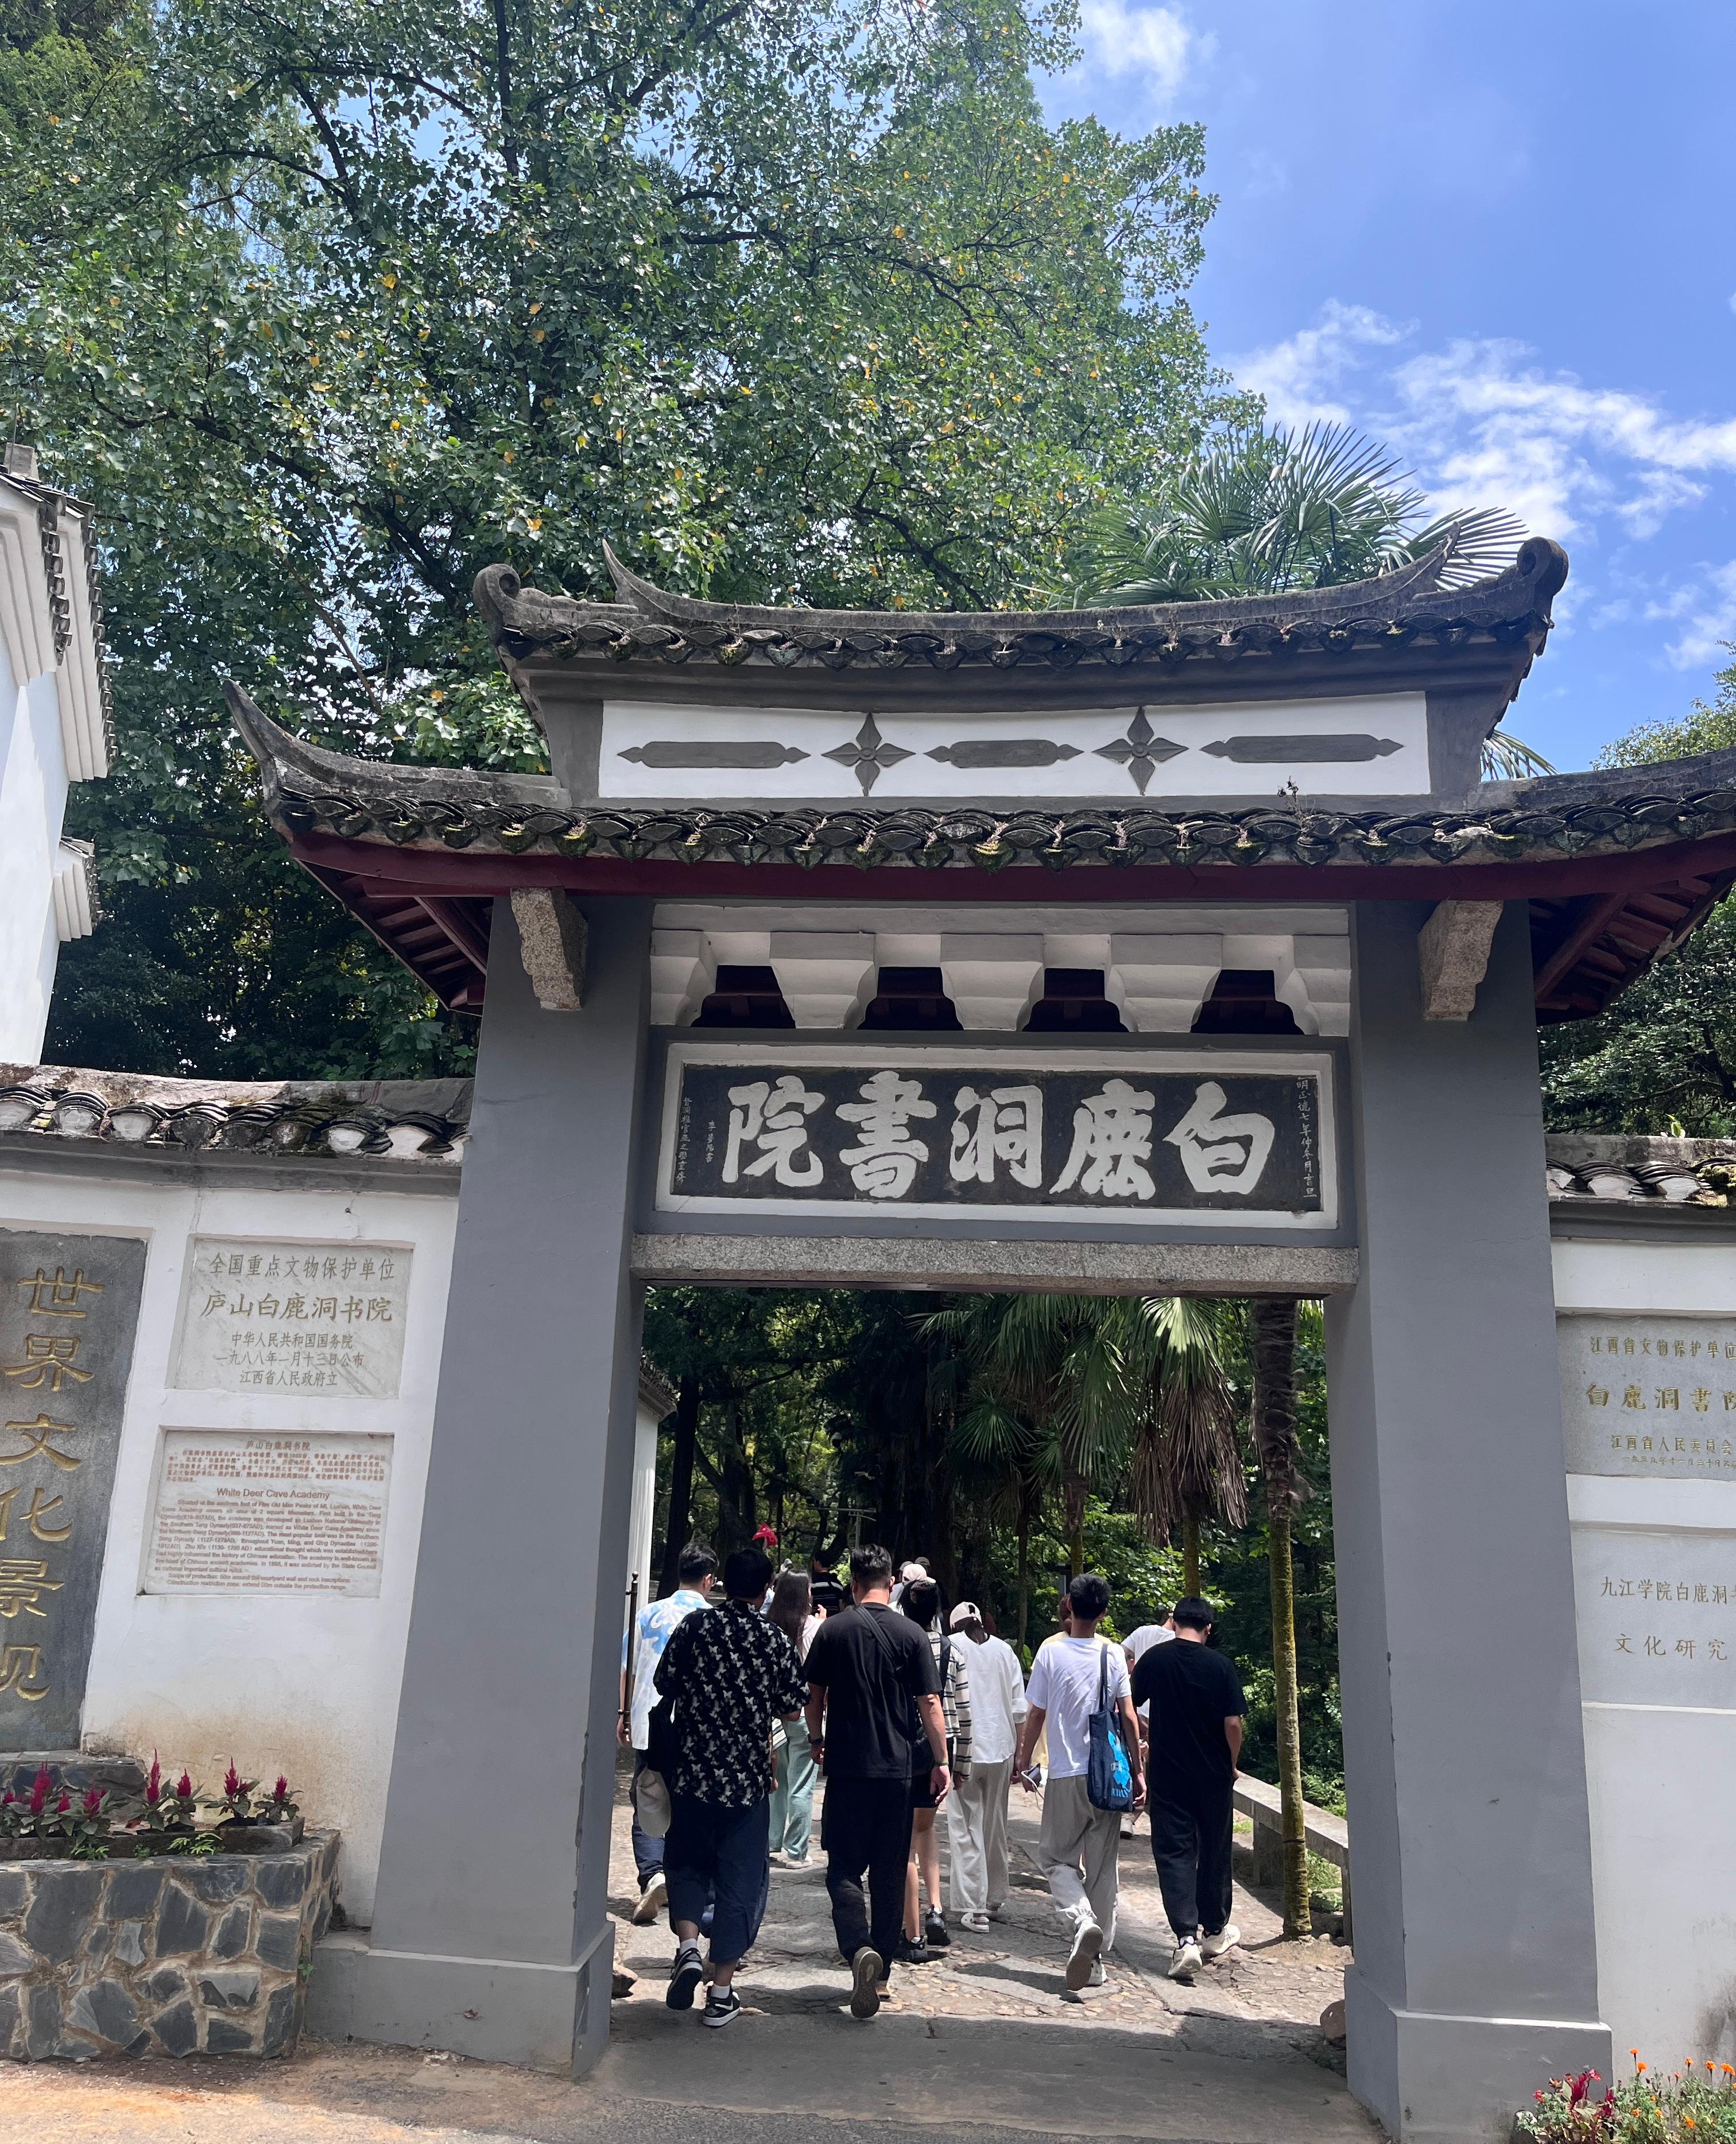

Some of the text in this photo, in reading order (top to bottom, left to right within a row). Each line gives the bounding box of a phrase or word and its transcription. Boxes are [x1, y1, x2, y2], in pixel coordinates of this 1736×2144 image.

[209, 1252, 395, 1281] 全国重点文物保护单位
[201, 1290, 394, 1324] 庐山白鹿洞书院
[231, 1331, 354, 1349] 中华人民共和国国务院
[1590, 1336, 1736, 1359] 江西省文物保护单位
[216, 1349, 364, 1368] 一九八八年一月十三日公布
[239, 1370, 338, 1387] 江西省人民政府立
[246, 1440, 310, 1451] 庐山白鹿洞书院
[1611, 1434, 1733, 1455] 江西省人民委员会
[217, 1488, 330, 1501] White Deer Cave Academy
[1613, 1633, 1727, 1661] 文化研究
